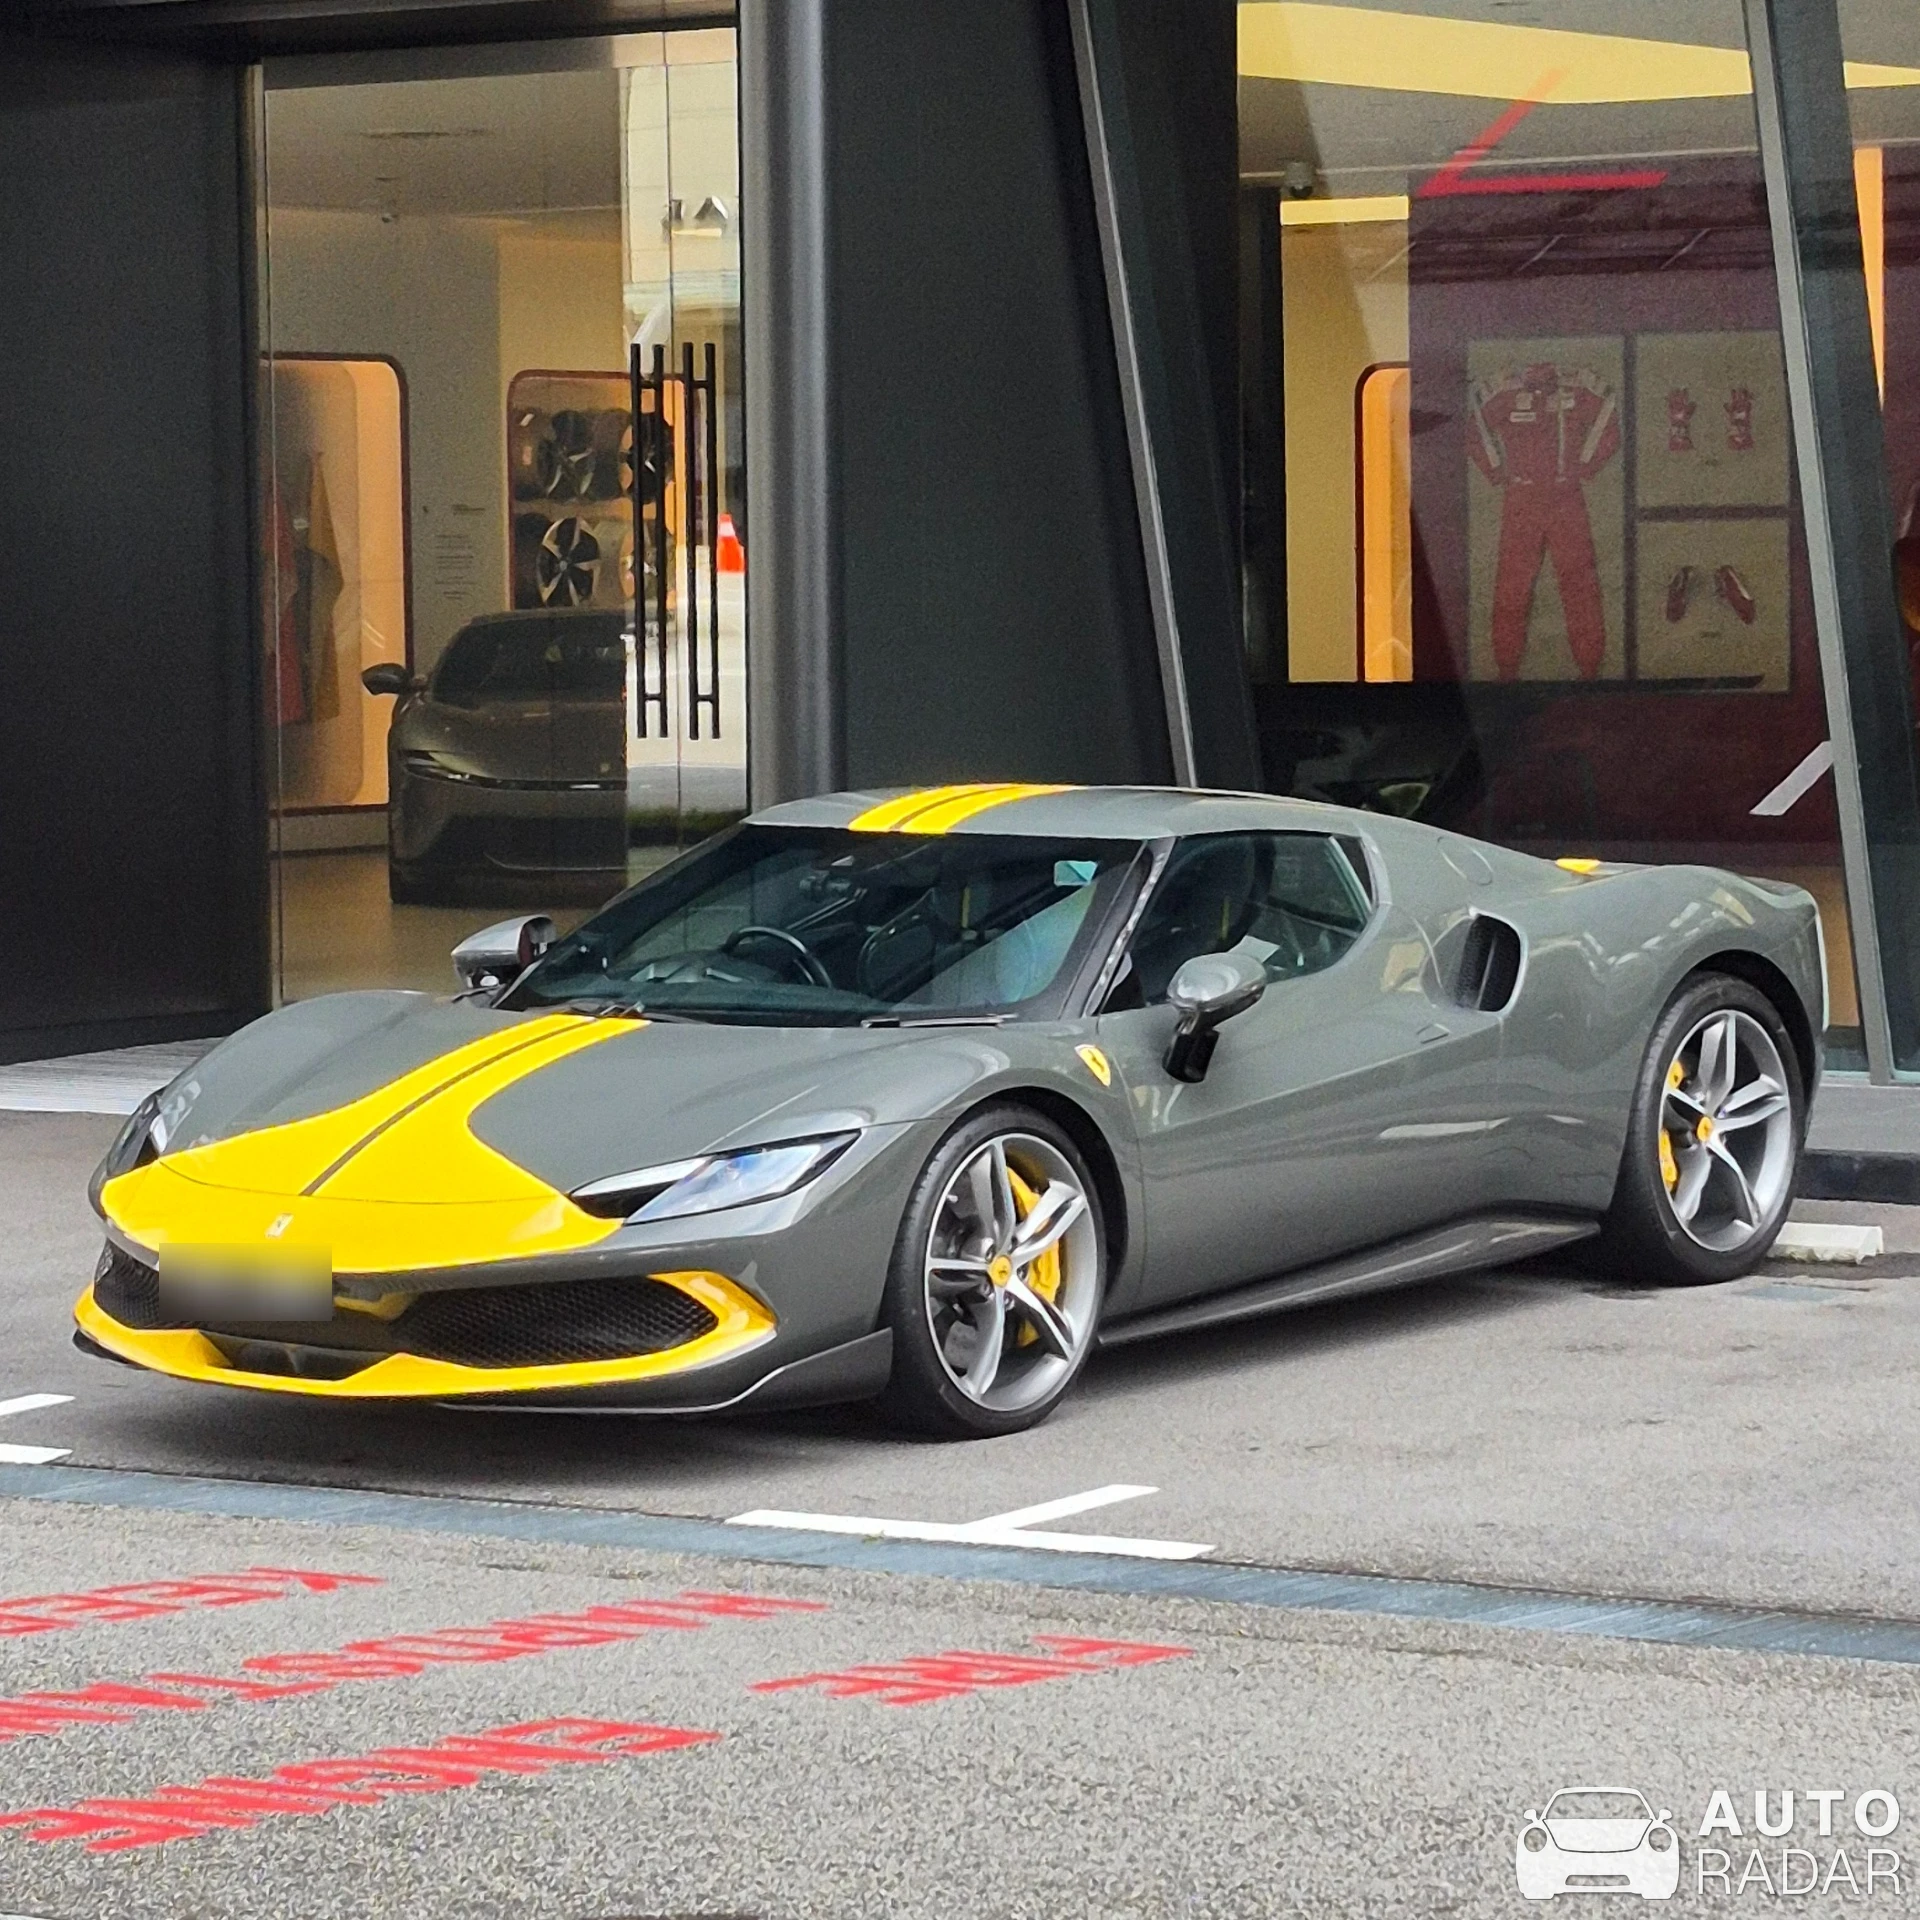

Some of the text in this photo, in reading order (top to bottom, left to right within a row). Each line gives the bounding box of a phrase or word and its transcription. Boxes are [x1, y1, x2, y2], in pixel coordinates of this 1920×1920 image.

[0, 1593, 828, 1743] HARDSTAN
[0, 1634, 1196, 1854] FIRE ENGINE
